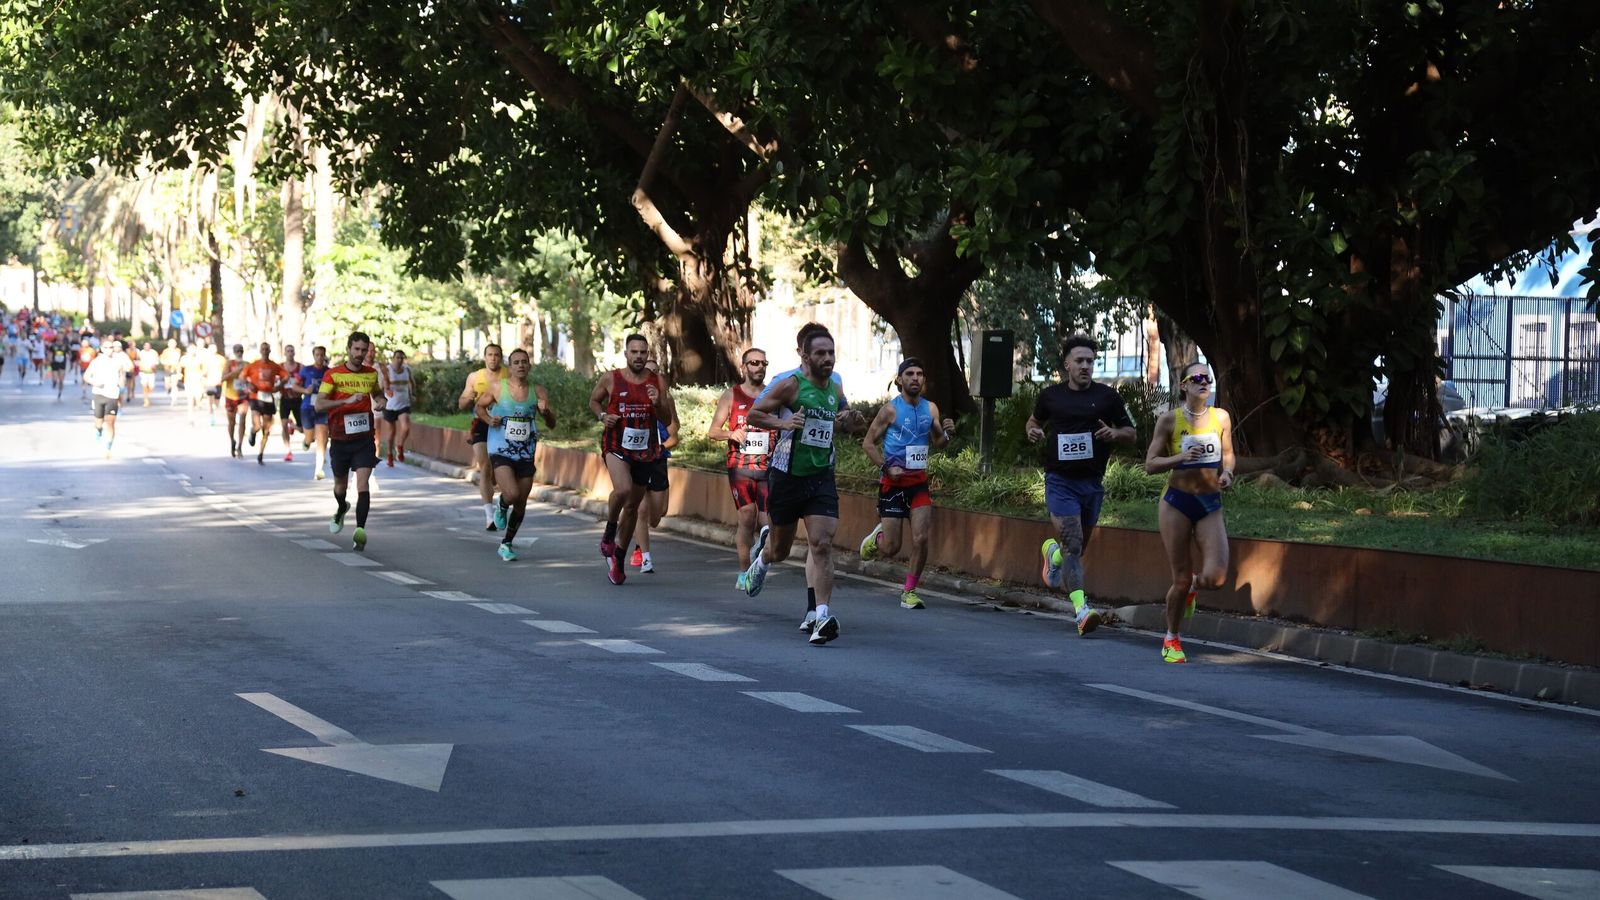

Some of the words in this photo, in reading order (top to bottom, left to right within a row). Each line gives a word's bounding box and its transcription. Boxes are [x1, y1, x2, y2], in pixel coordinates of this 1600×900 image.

[509, 428, 527, 436] 203
[808, 429, 830, 440] 410
[627, 435, 645, 444] 787
[1062, 442, 1087, 453] 226
